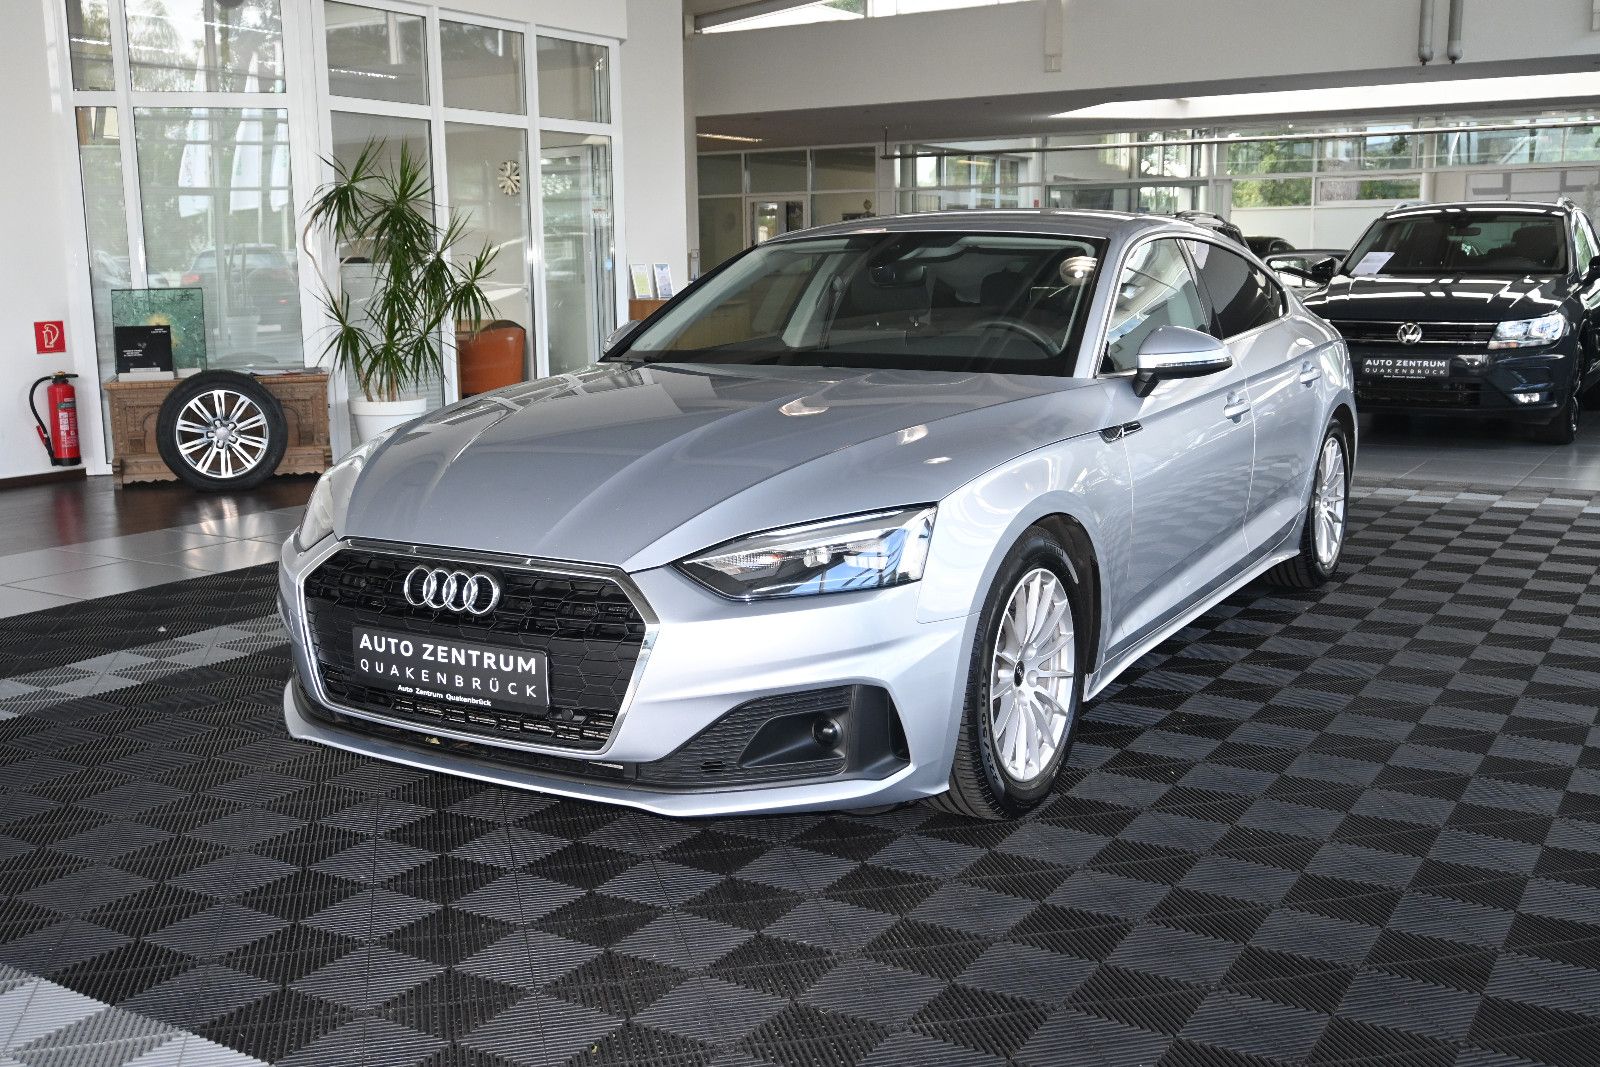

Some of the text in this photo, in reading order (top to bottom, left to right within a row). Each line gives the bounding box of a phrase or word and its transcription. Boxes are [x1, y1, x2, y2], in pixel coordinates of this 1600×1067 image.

[1365, 367, 1445, 375] QUAKENBRÜCK
[360, 634, 536, 675] AUTO ZENTRUM
[360, 658, 537, 698] QUAKENBRÜCK
[397, 684, 492, 707] Auto Zentrum Quakenbrück
